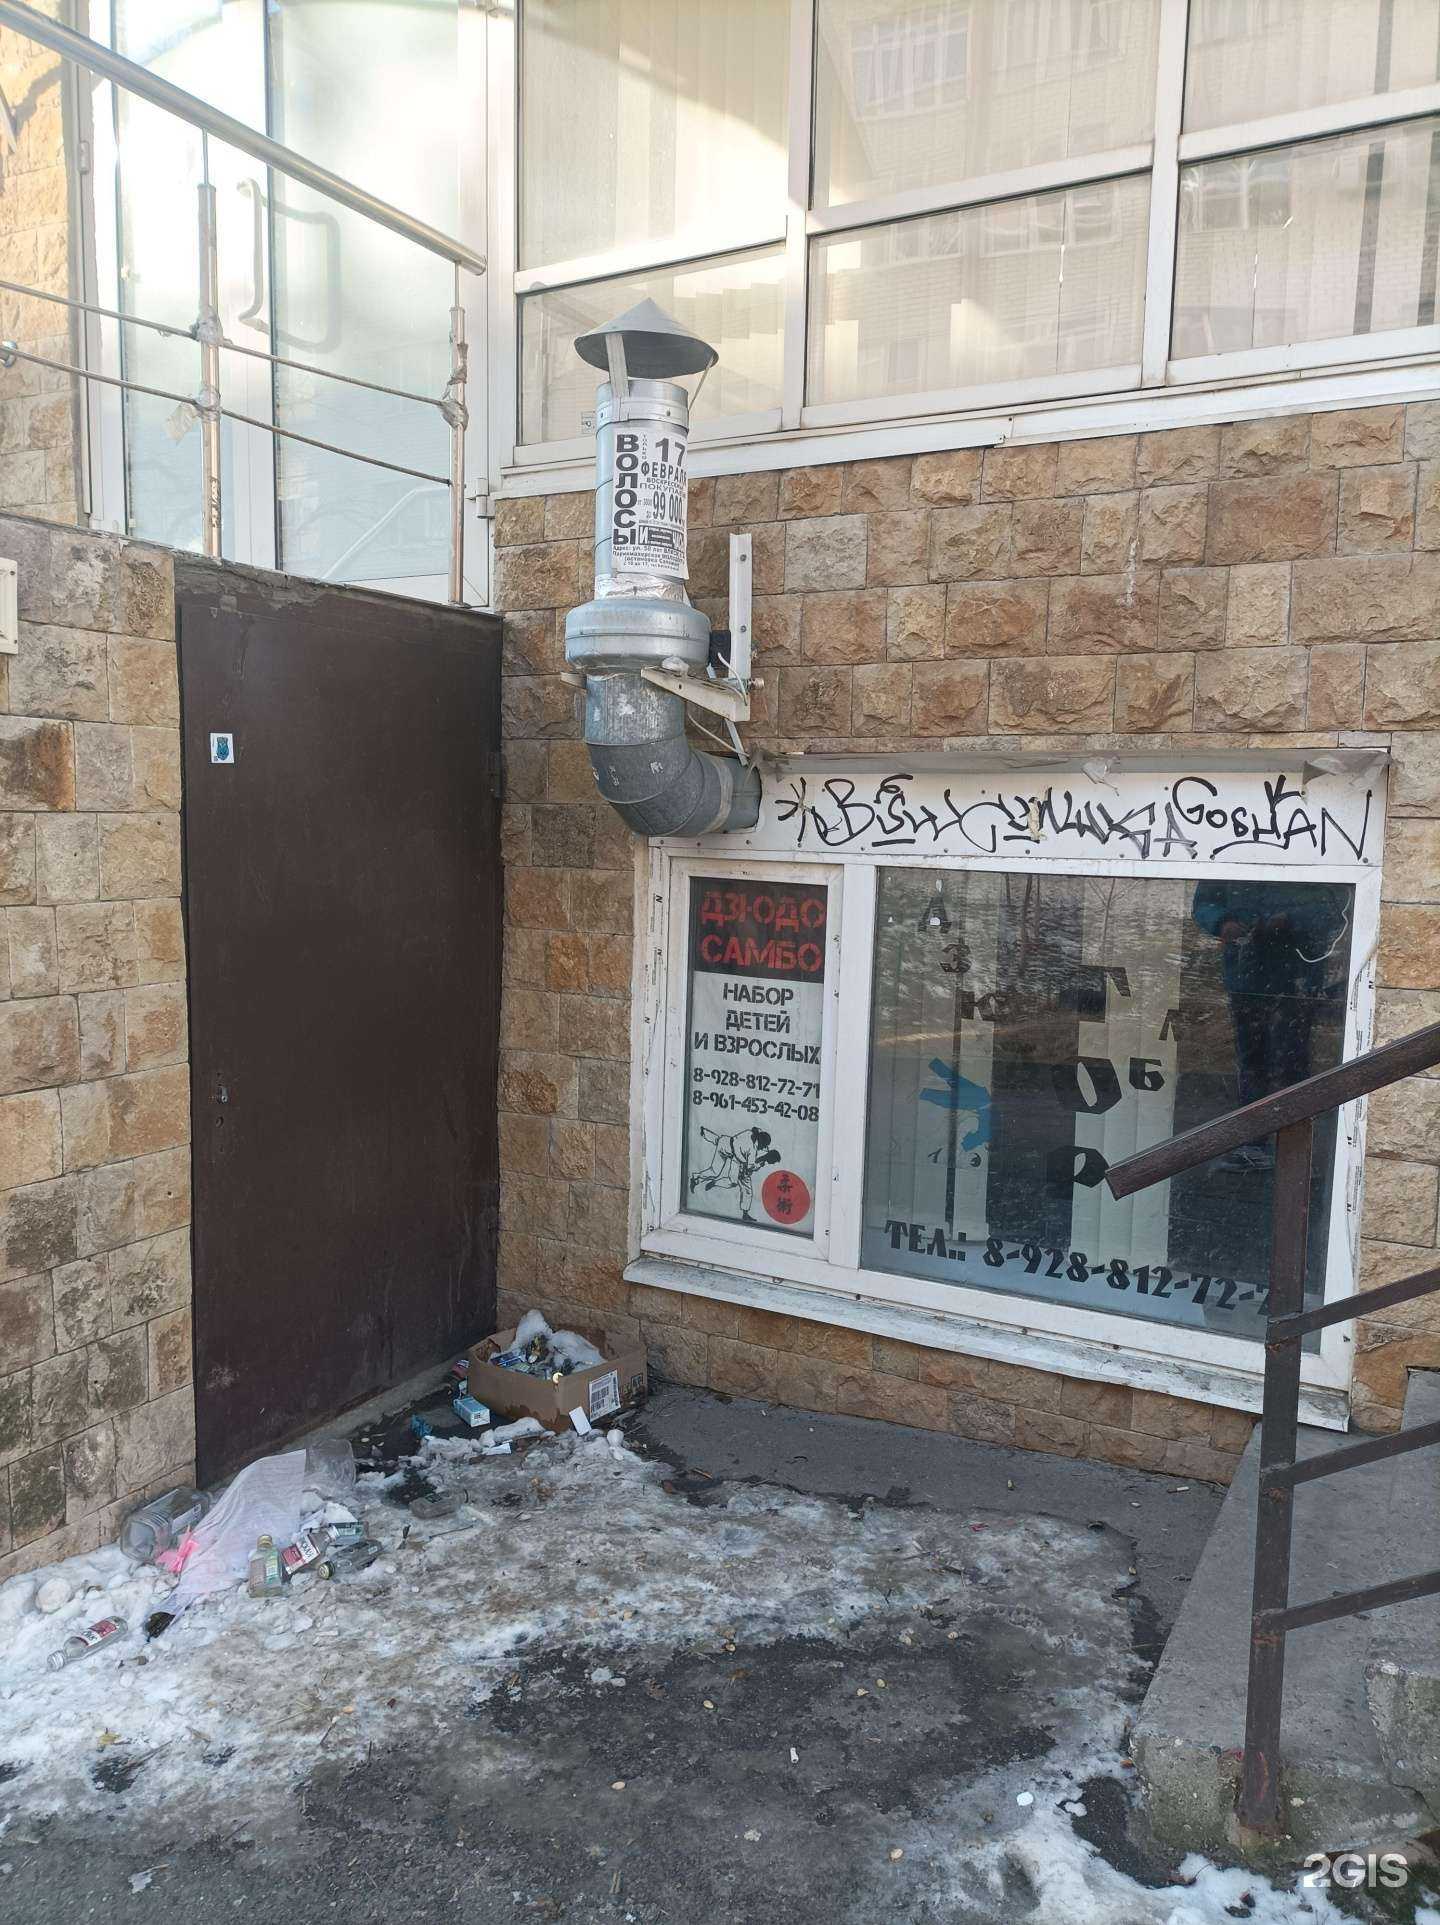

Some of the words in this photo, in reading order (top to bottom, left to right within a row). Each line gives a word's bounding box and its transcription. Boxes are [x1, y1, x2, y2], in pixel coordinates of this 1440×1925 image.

[655, 437, 686, 467] 17
[613, 434, 640, 545] ВОЛОСЫ
[702, 891, 826, 934] ДЗЮДО
[701, 934, 823, 973] САМБО
[723, 982, 794, 1007] НАБОР
[726, 1009, 791, 1034] ДЕТЕЙ
[694, 1032, 709, 1051] И
[713, 1034, 821, 1065] ВЗРОСЛЫХ
[693, 1067, 820, 1100] 8-928-812-72-71
[692, 1090, 820, 1123] 8-961-453-42-08
